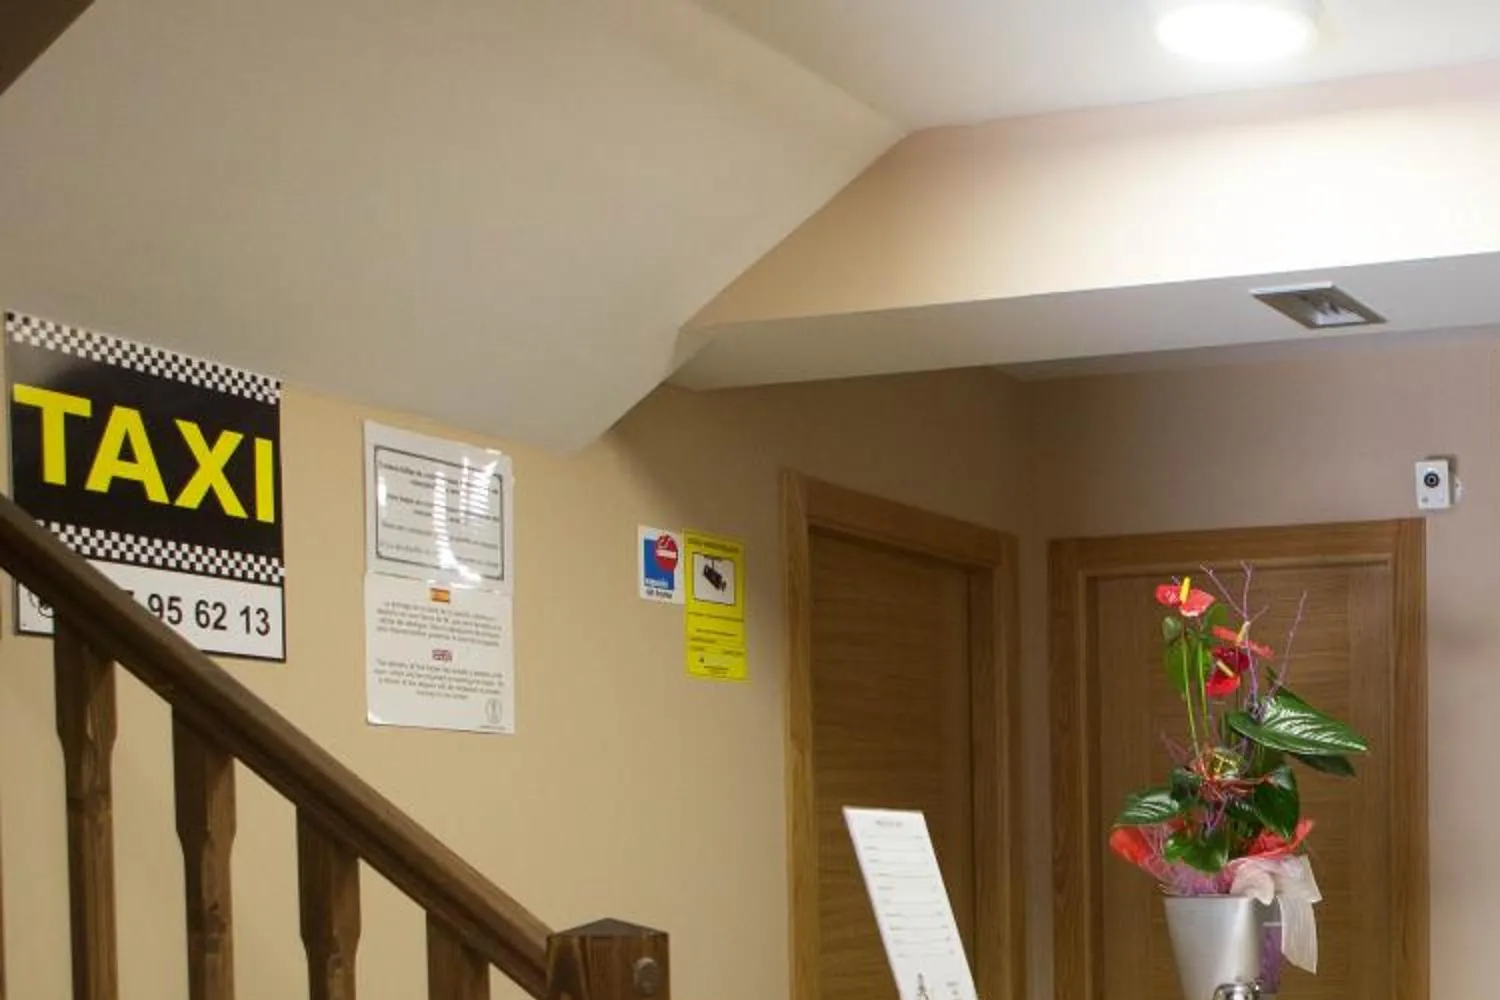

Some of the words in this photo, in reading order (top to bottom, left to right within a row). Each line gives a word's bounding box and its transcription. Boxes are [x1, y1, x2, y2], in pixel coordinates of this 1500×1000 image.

[13, 383, 275, 524] TAXI
[147, 593, 183, 626] 95
[195, 599, 228, 631] 62
[239, 605, 271, 637] 13
